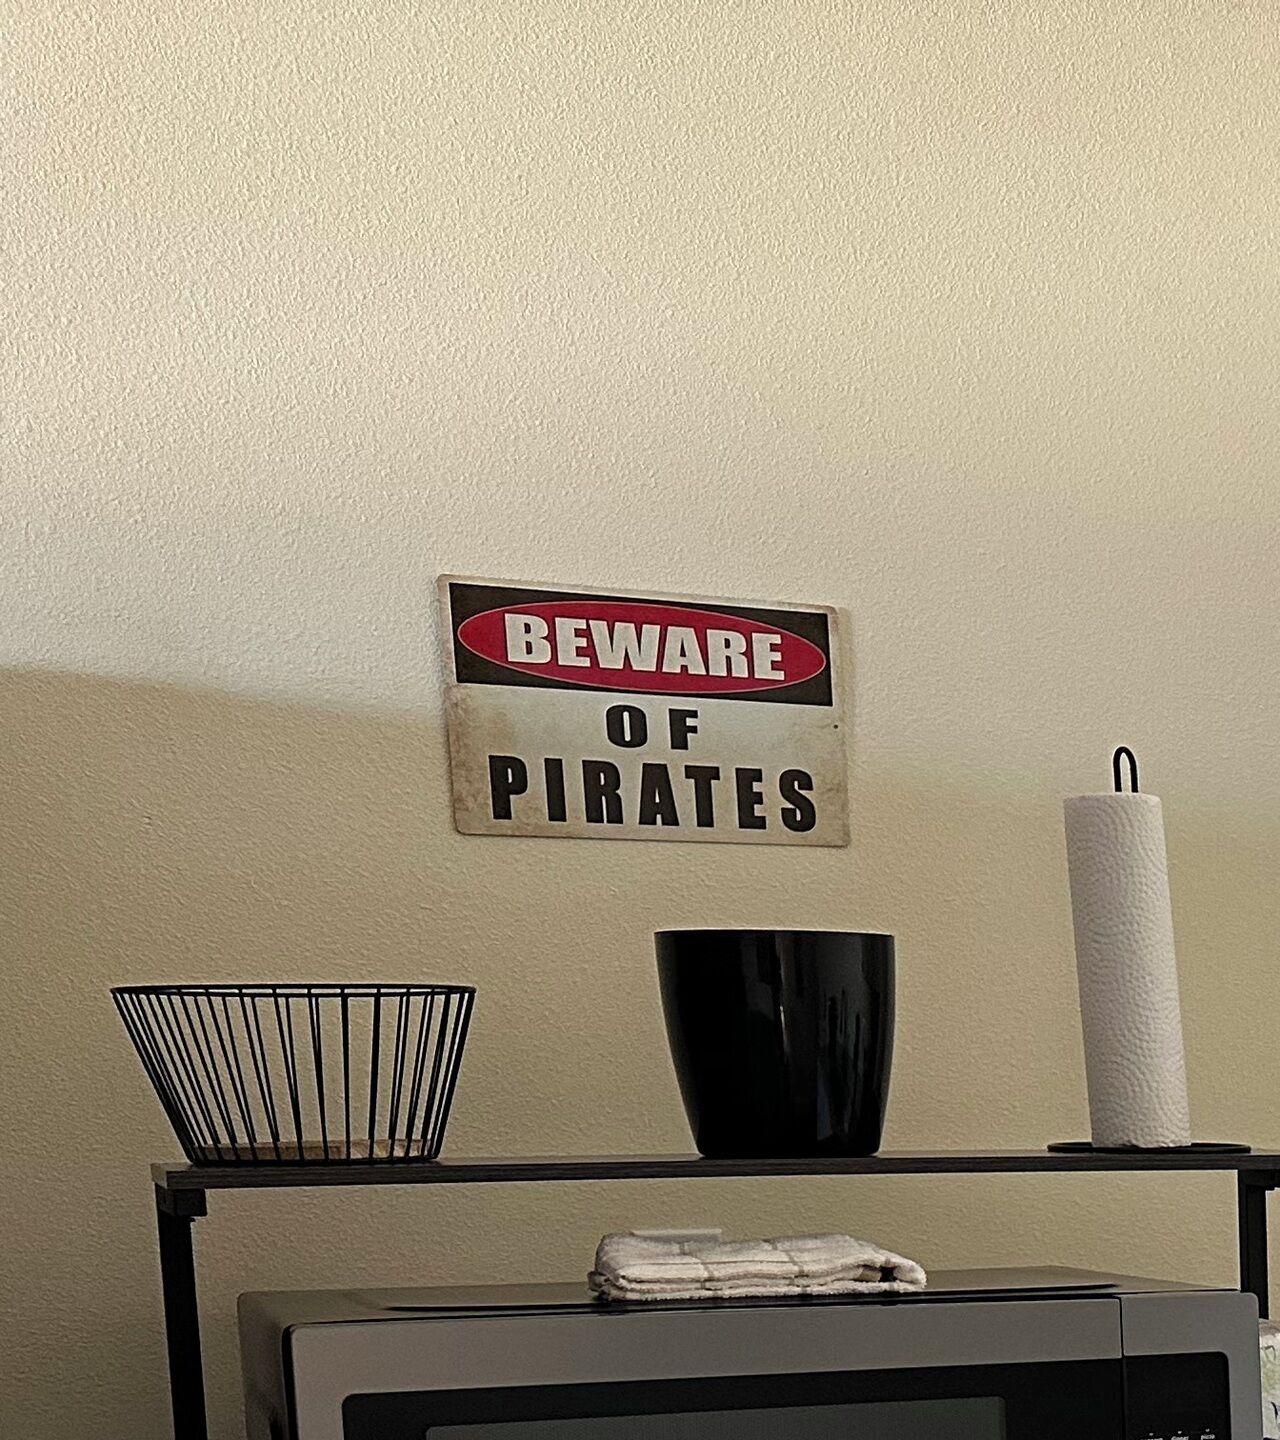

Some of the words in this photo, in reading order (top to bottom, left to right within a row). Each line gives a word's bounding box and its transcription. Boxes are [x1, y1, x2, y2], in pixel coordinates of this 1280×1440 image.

[503, 613, 785, 681] BEWARE
[605, 703, 699, 750] OF
[488, 755, 816, 833] PIRATES
